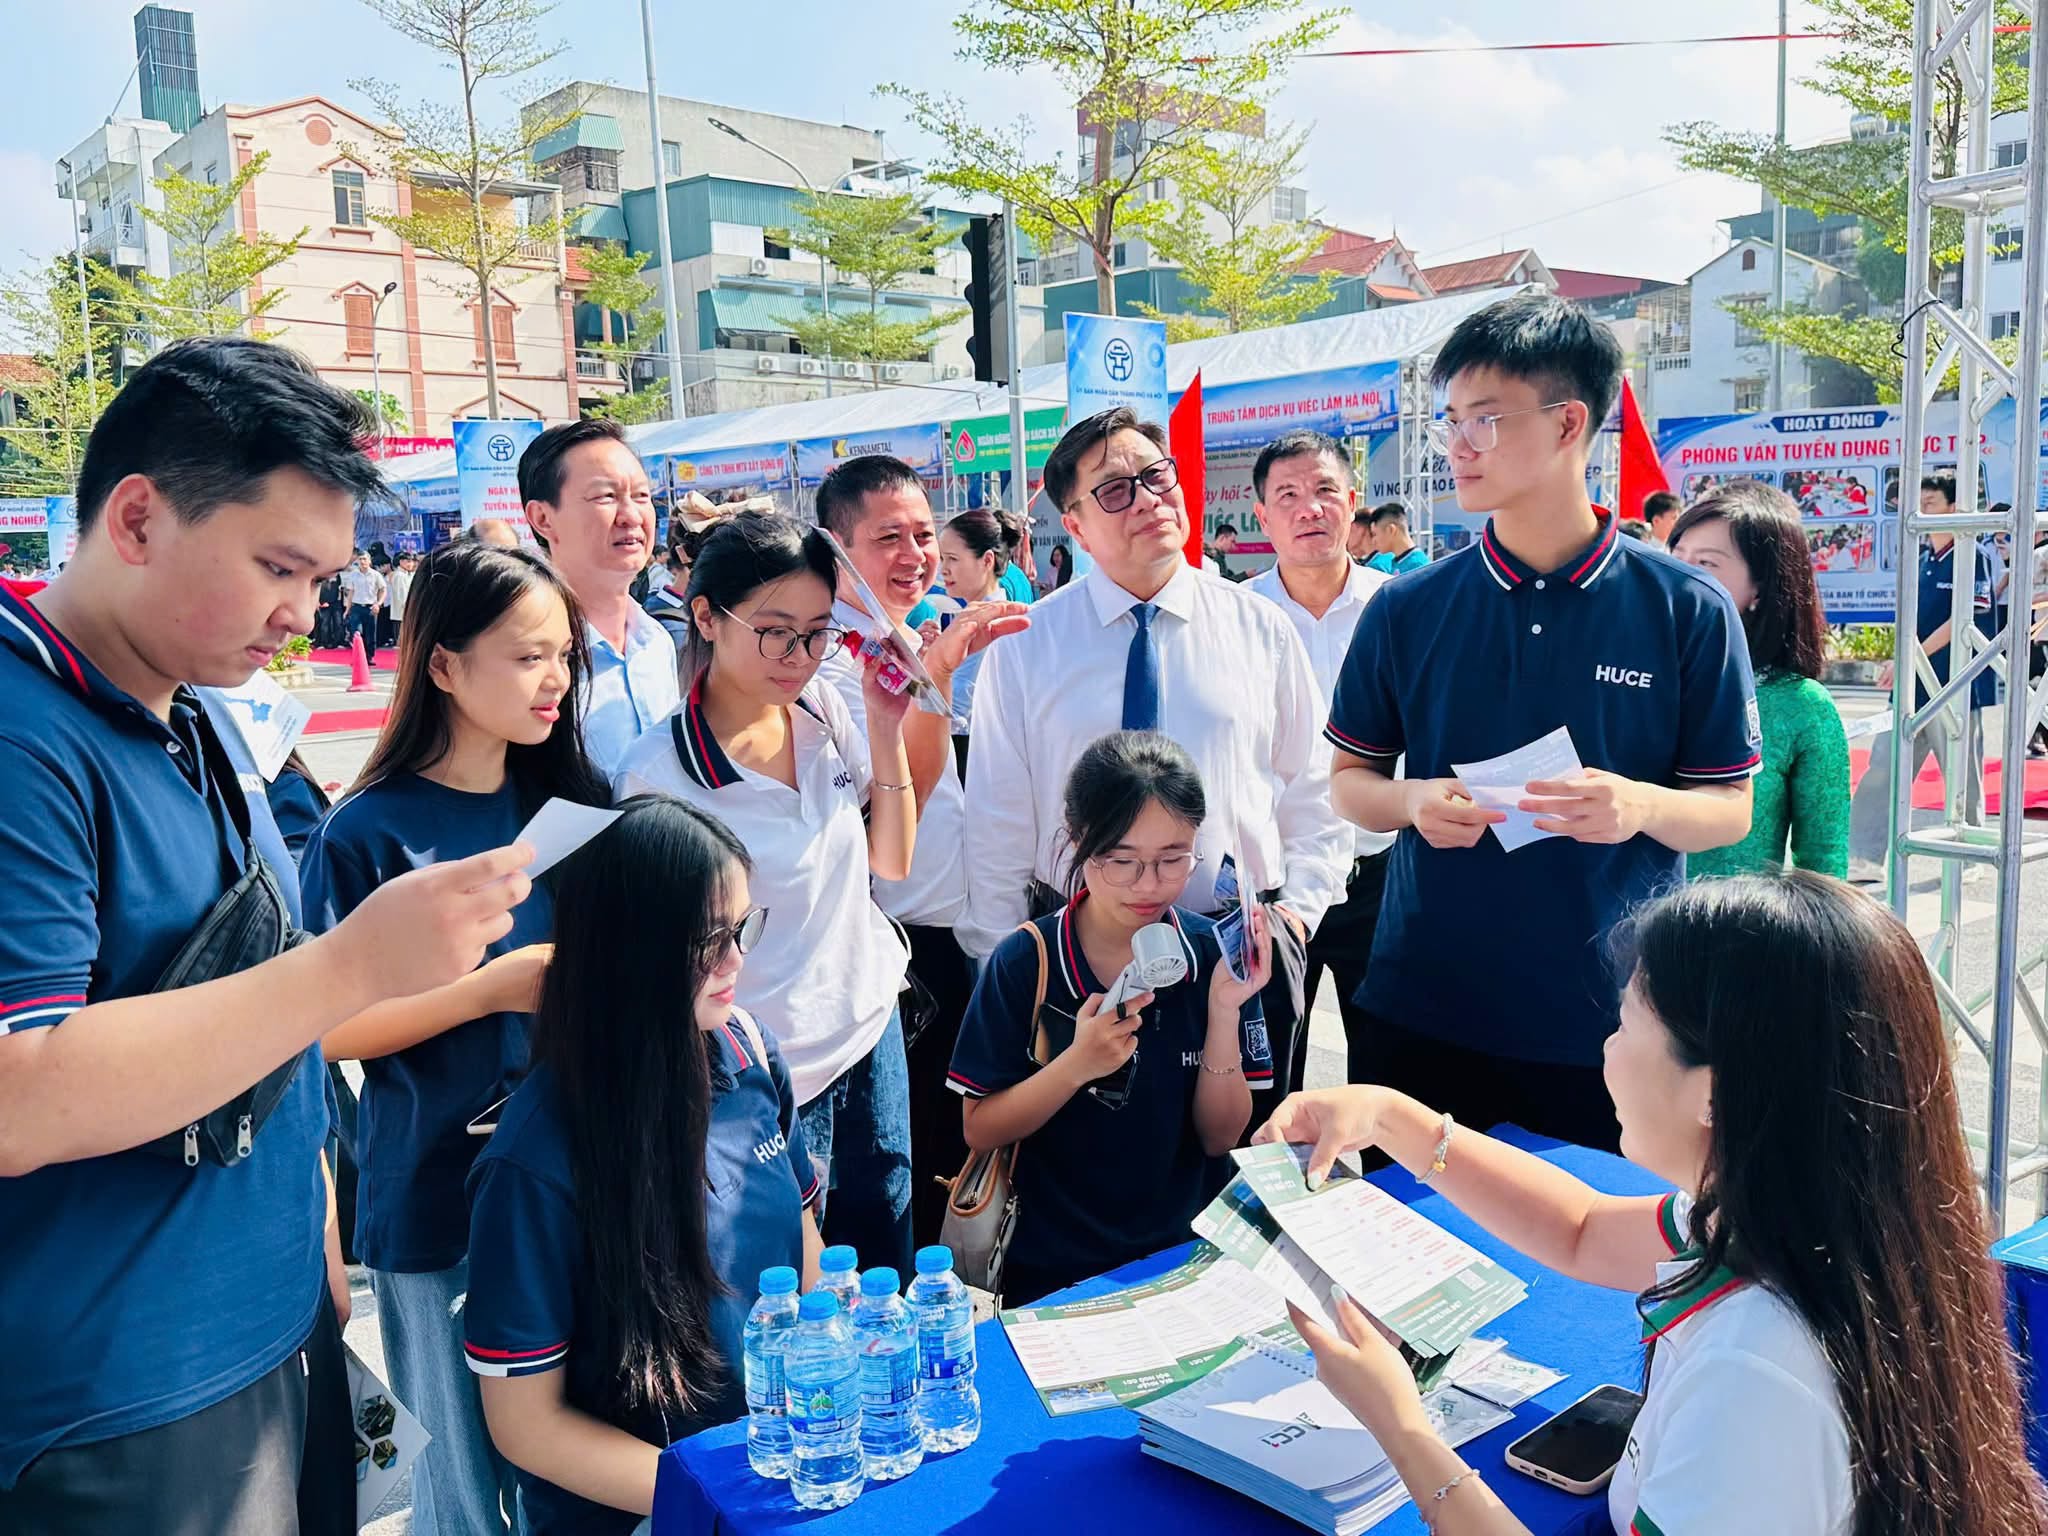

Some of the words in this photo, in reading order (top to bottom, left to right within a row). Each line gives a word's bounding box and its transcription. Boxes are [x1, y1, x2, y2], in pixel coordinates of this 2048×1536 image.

[1207, 408, 1236, 425] TRUNG
[1237, 405, 1257, 420] TÂM
[1259, 403, 1280, 422] DỊCH
[1283, 403, 1295, 418] VỤ
[1297, 398, 1318, 416] VIỆC
[1321, 391, 1342, 411] LÀM
[1362, 391, 1380, 406] NỘI
[1783, 416, 1825, 434] HOẠT
[1832, 412, 1875, 431] ĐỘNG
[850, 441, 893, 457] KENNAMETAL
[1682, 441, 1738, 465] PHỎNG
[1743, 437, 1778, 461] VẤN
[1784, 435, 1836, 459] TUYỂN
[1842, 438, 1889, 463] DỤNG
[1220, 486, 1241, 504] hội
[1373, 481, 1384, 497] VÌ
[1595, 664, 1653, 688] HUCE
[832, 771, 852, 791] HUC
